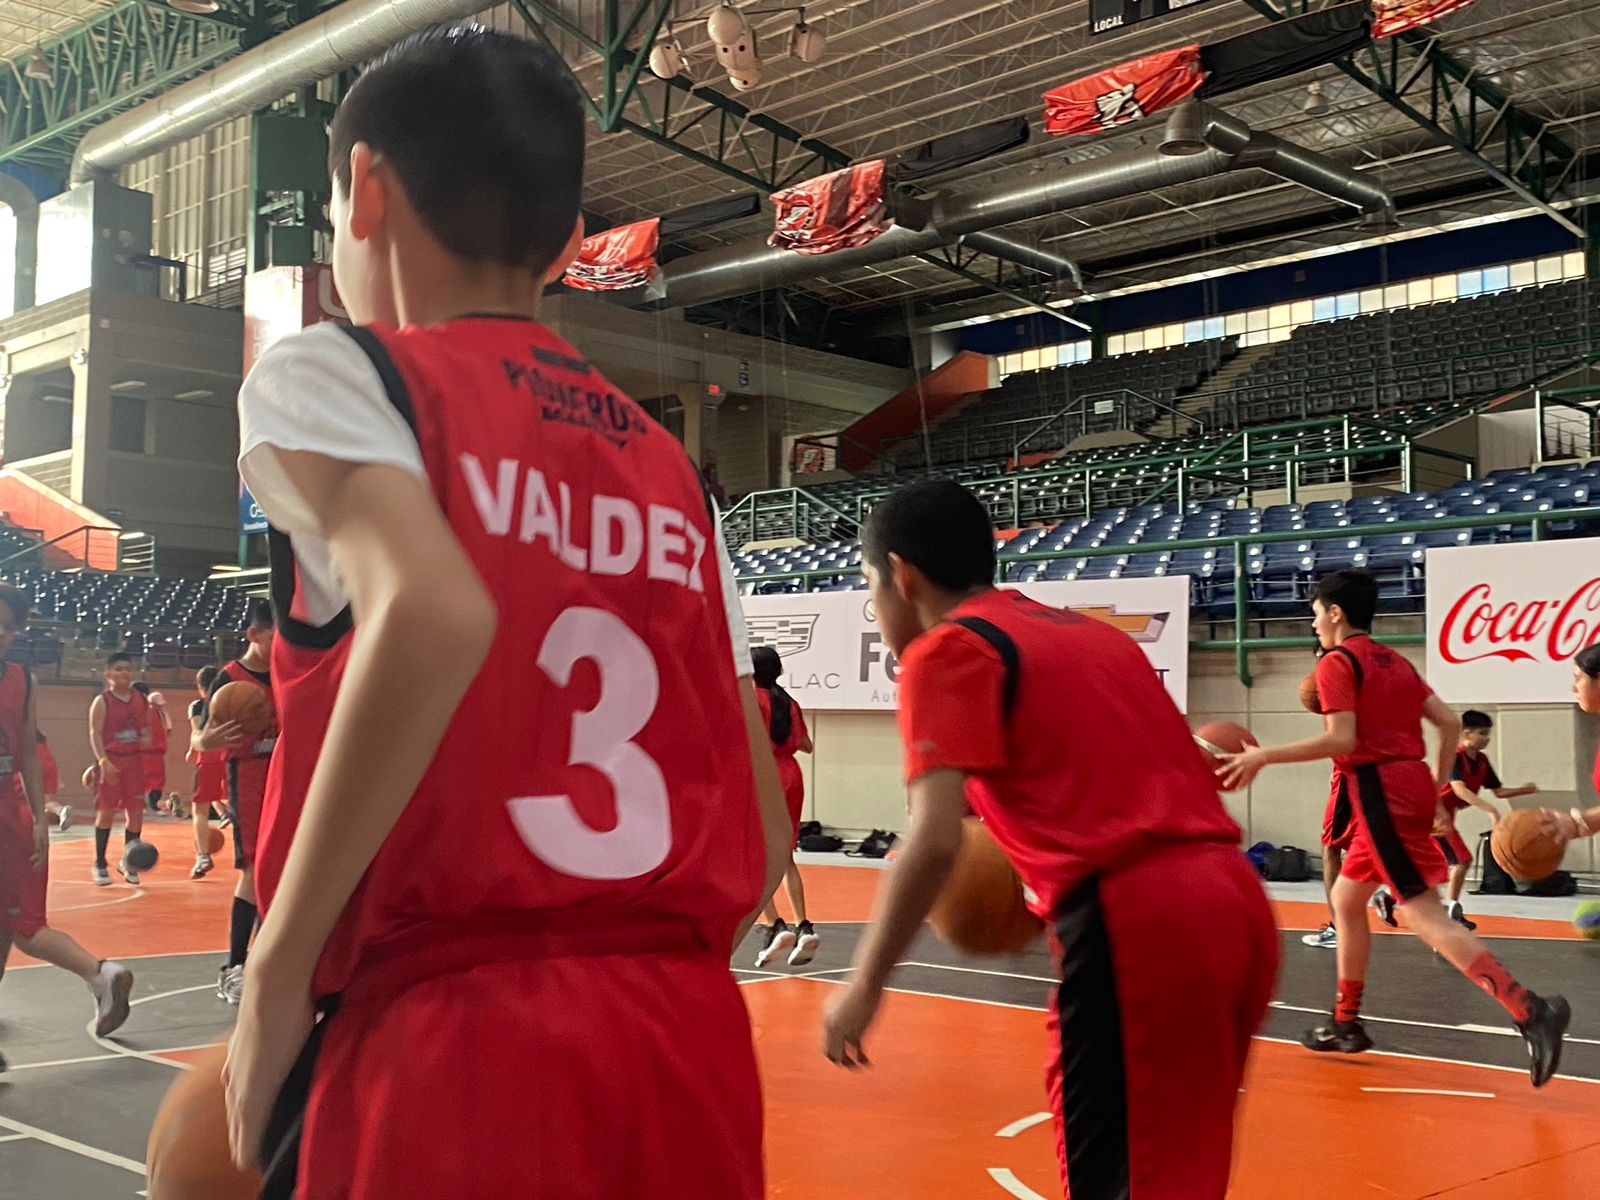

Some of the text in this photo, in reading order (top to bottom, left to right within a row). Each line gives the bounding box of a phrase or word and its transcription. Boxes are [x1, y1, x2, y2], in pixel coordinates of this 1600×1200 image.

[1094, 15, 1124, 33] LOCAL
[458, 452, 706, 593] VALDEZ
[783, 673, 840, 689] LAC
[859, 632, 900, 683] Fe
[505, 606, 674, 880] 3
